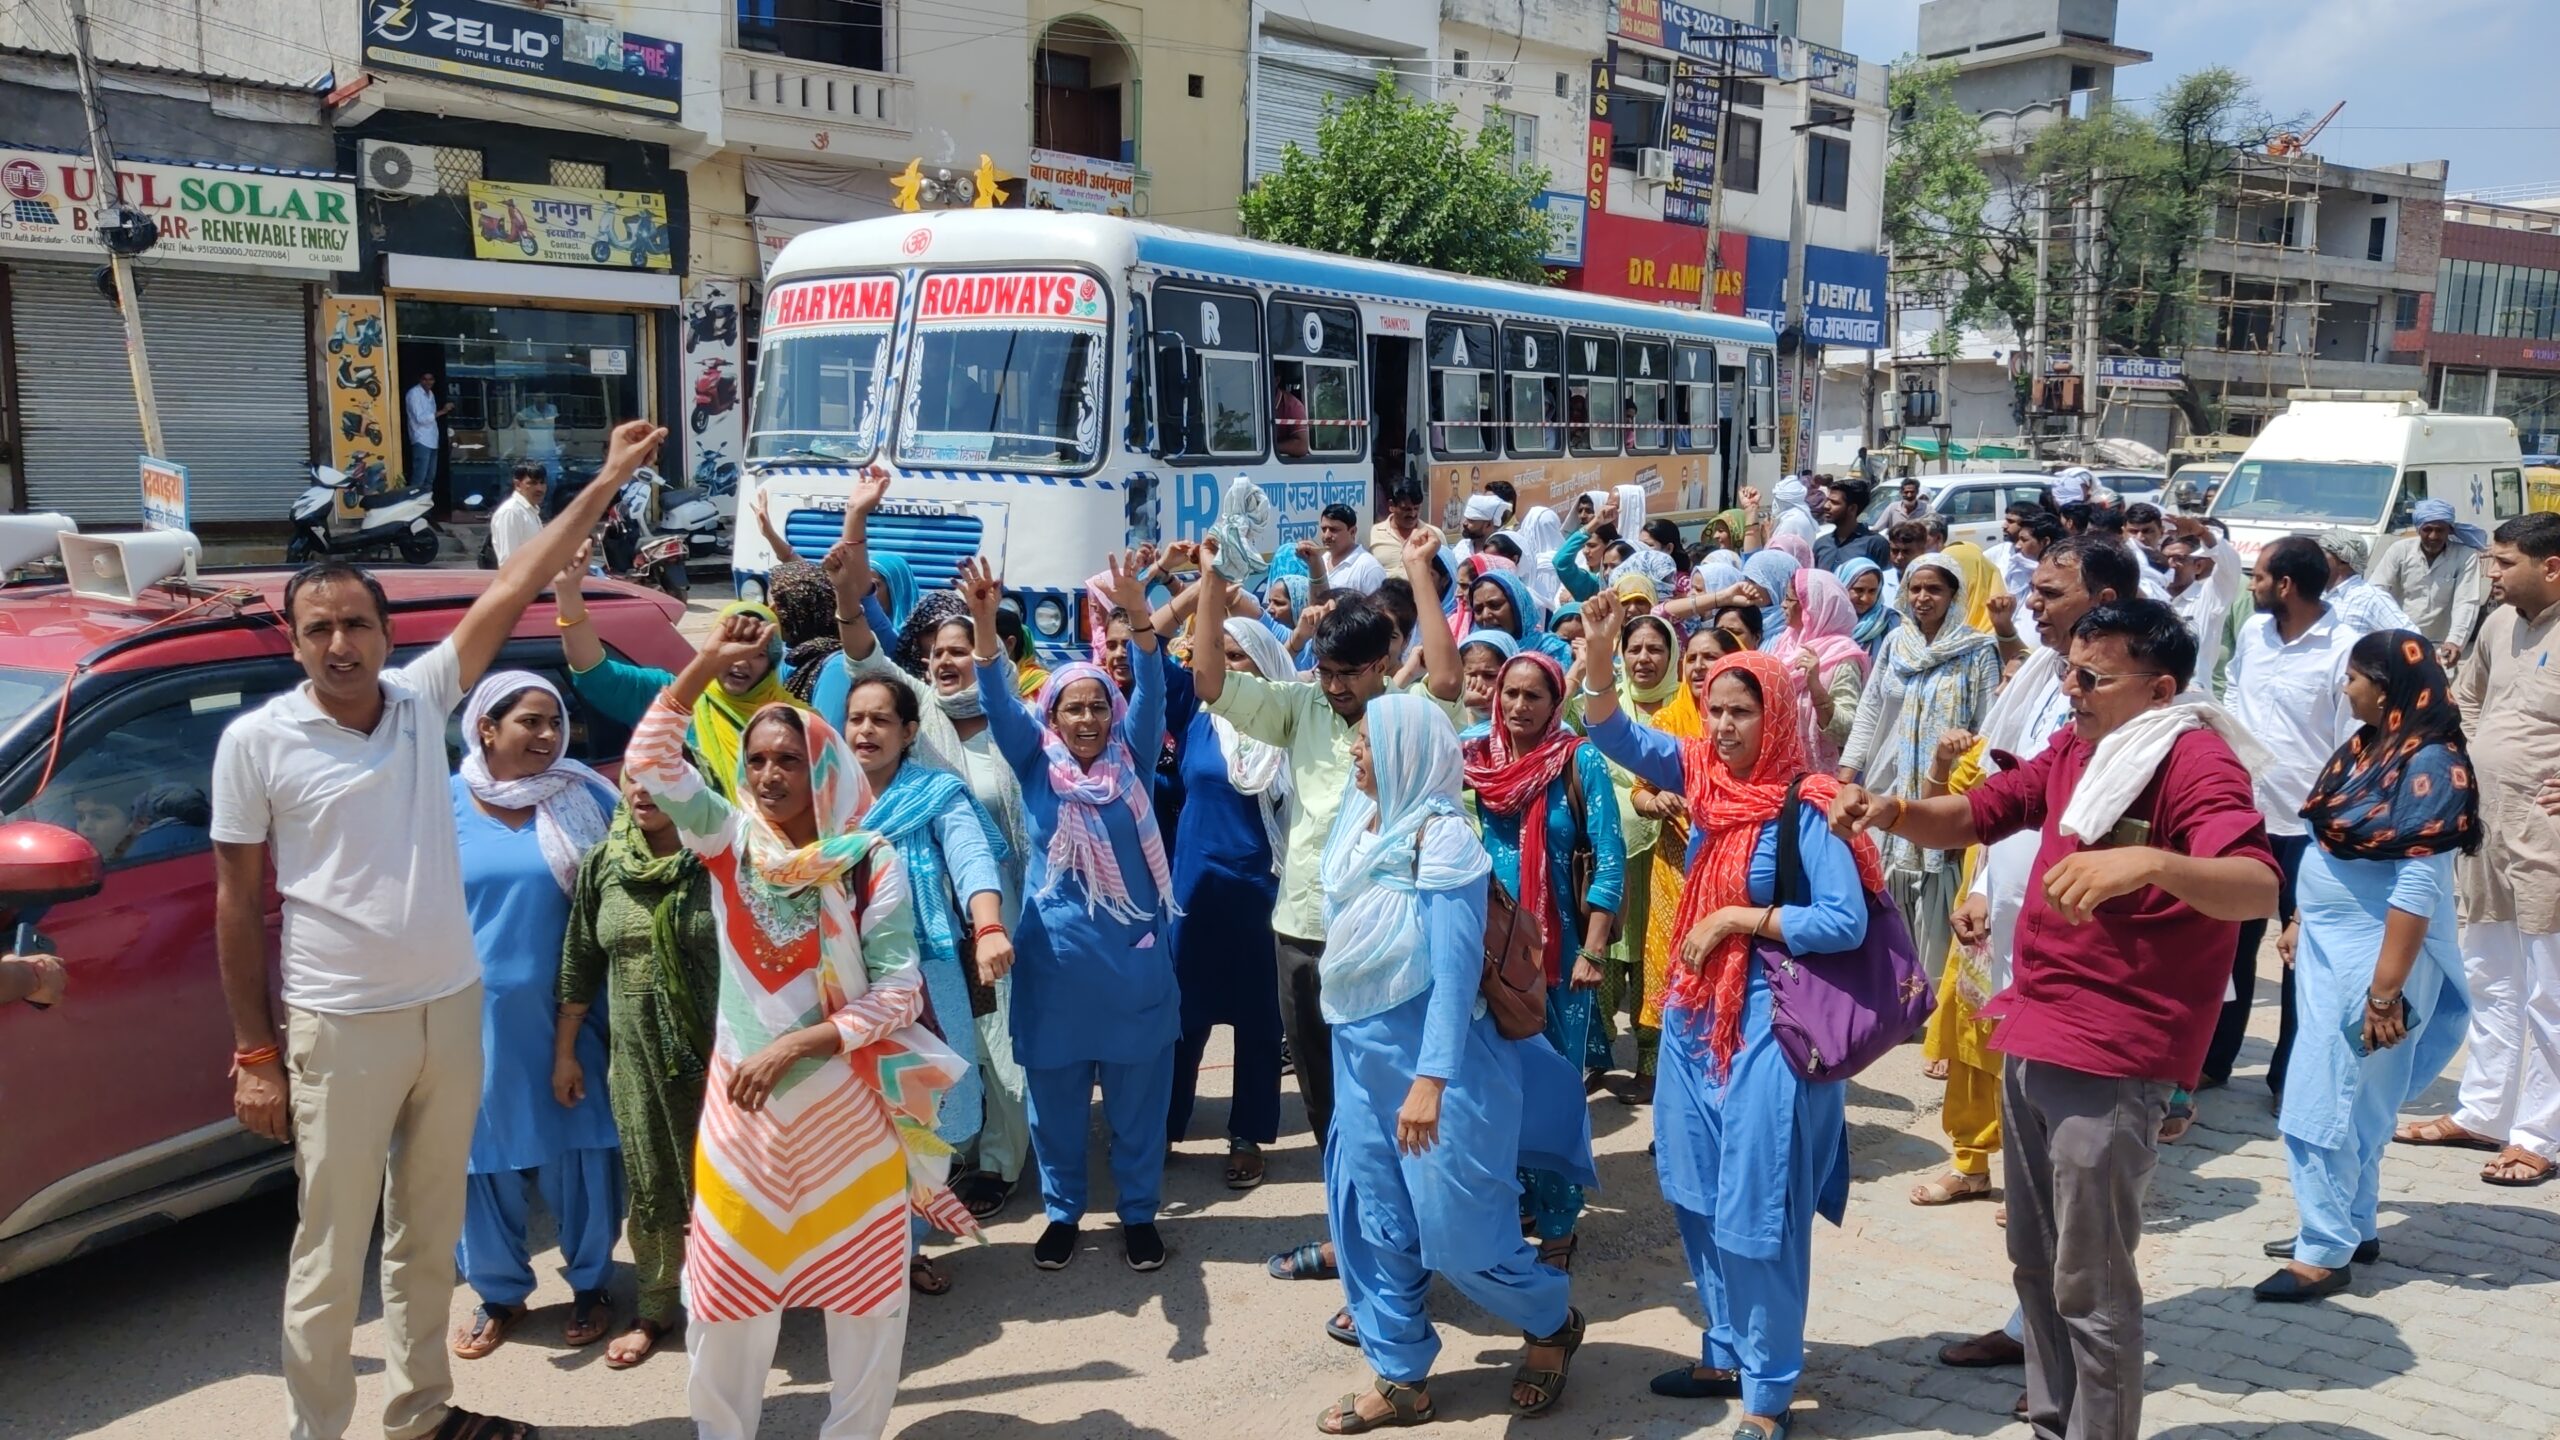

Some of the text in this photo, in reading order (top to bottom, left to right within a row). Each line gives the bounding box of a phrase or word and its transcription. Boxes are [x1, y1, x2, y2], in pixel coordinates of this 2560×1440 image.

[1662, 3, 1690, 27] HCS
[427, 11, 549, 58] ZELIO
[1680, 31, 1713, 57] ANIL
[455, 47, 490, 62] FUTURE
[493, 54, 502, 63] IS
[505, 56, 545, 71] ELECTRIC
[1671, 124, 1688, 142] 24
[1589, 136, 1606, 210] HCS
[180, 177, 351, 225] SOLAR
[531, 200, 593, 226] गुनगुन
[20, 222, 54, 233] Solar
[71, 235, 85, 245] GST
[201, 219, 297, 248] RENEWABLE
[301, 227, 349, 251] ENERGY
[777, 276, 1077, 325] HARYANA ROADWAYS
[1818, 282, 1874, 313] DENTAL
[1823, 315, 1881, 343] अस्पताल
[1288, 481, 1319, 514] राज्य
[1320, 470, 1367, 508] परिवहन
